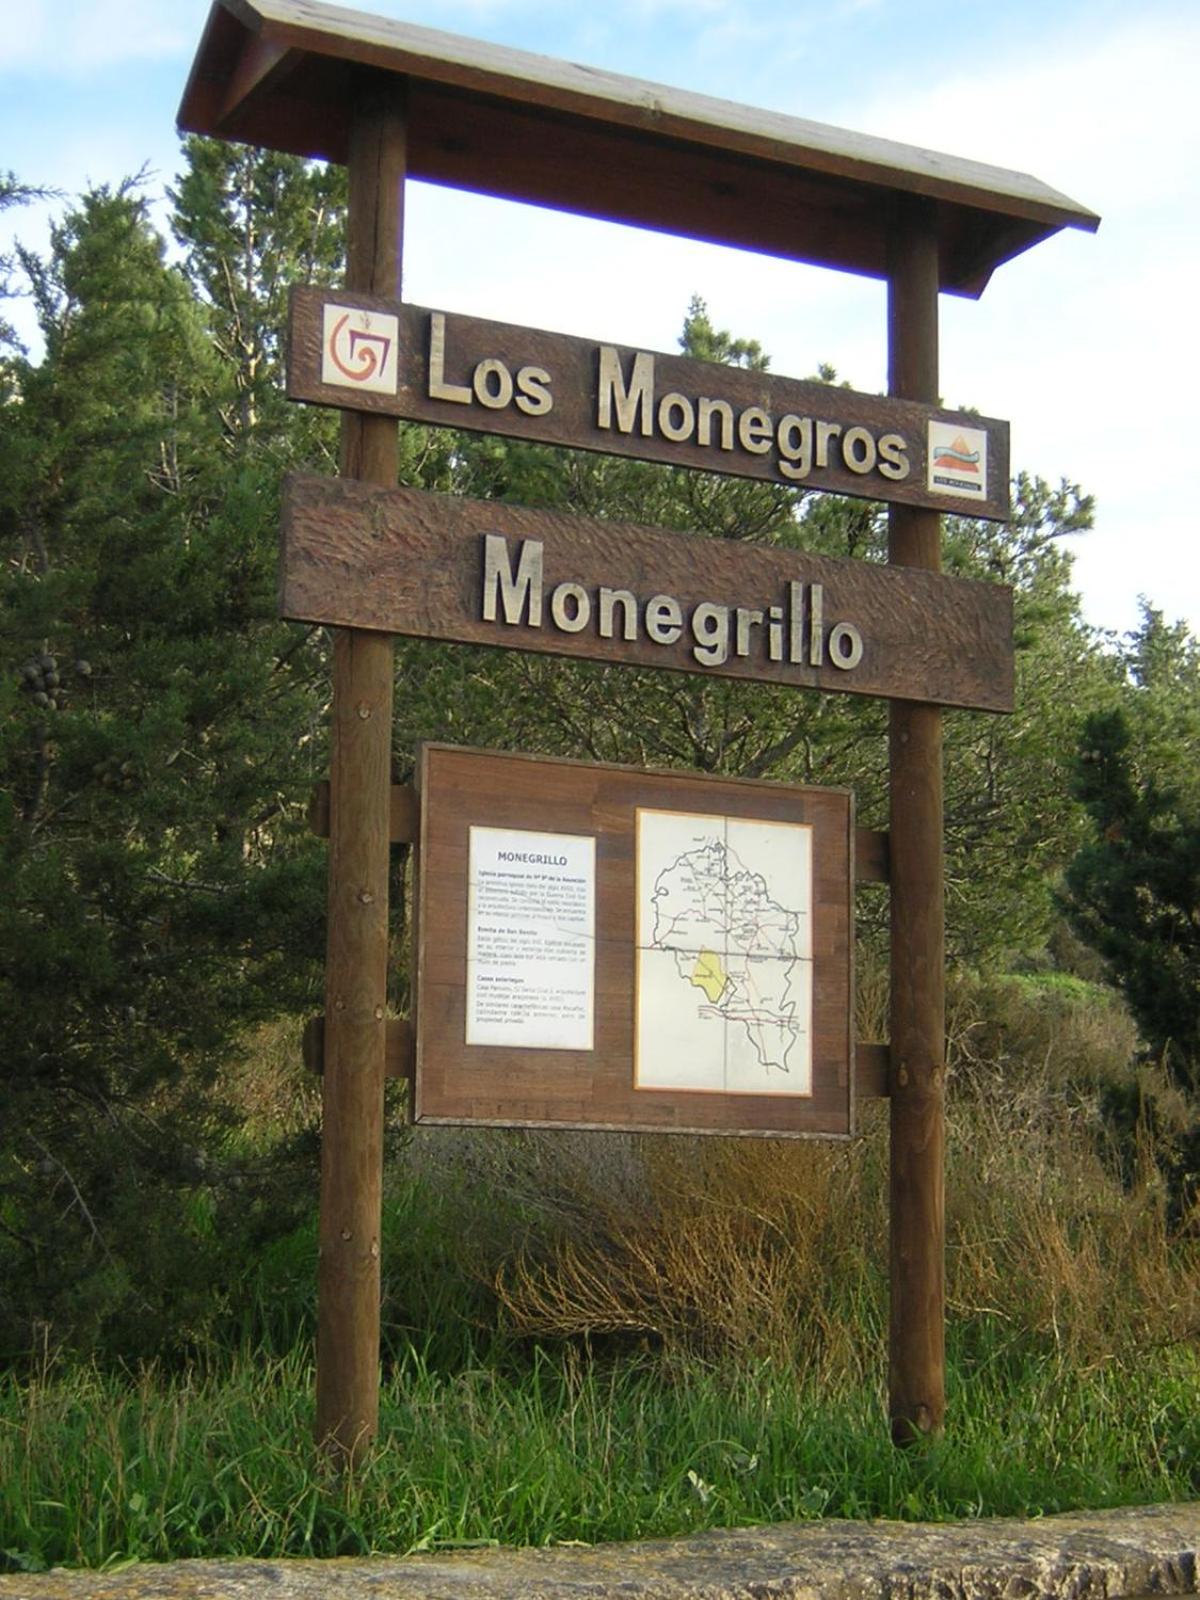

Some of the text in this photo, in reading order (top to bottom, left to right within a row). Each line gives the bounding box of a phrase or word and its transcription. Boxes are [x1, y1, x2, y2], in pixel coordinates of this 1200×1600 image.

[427, 312, 911, 482] Los Monegros
[481, 534, 865, 671] Monegrillo
[497, 851, 568, 866] MONEGRILLO
